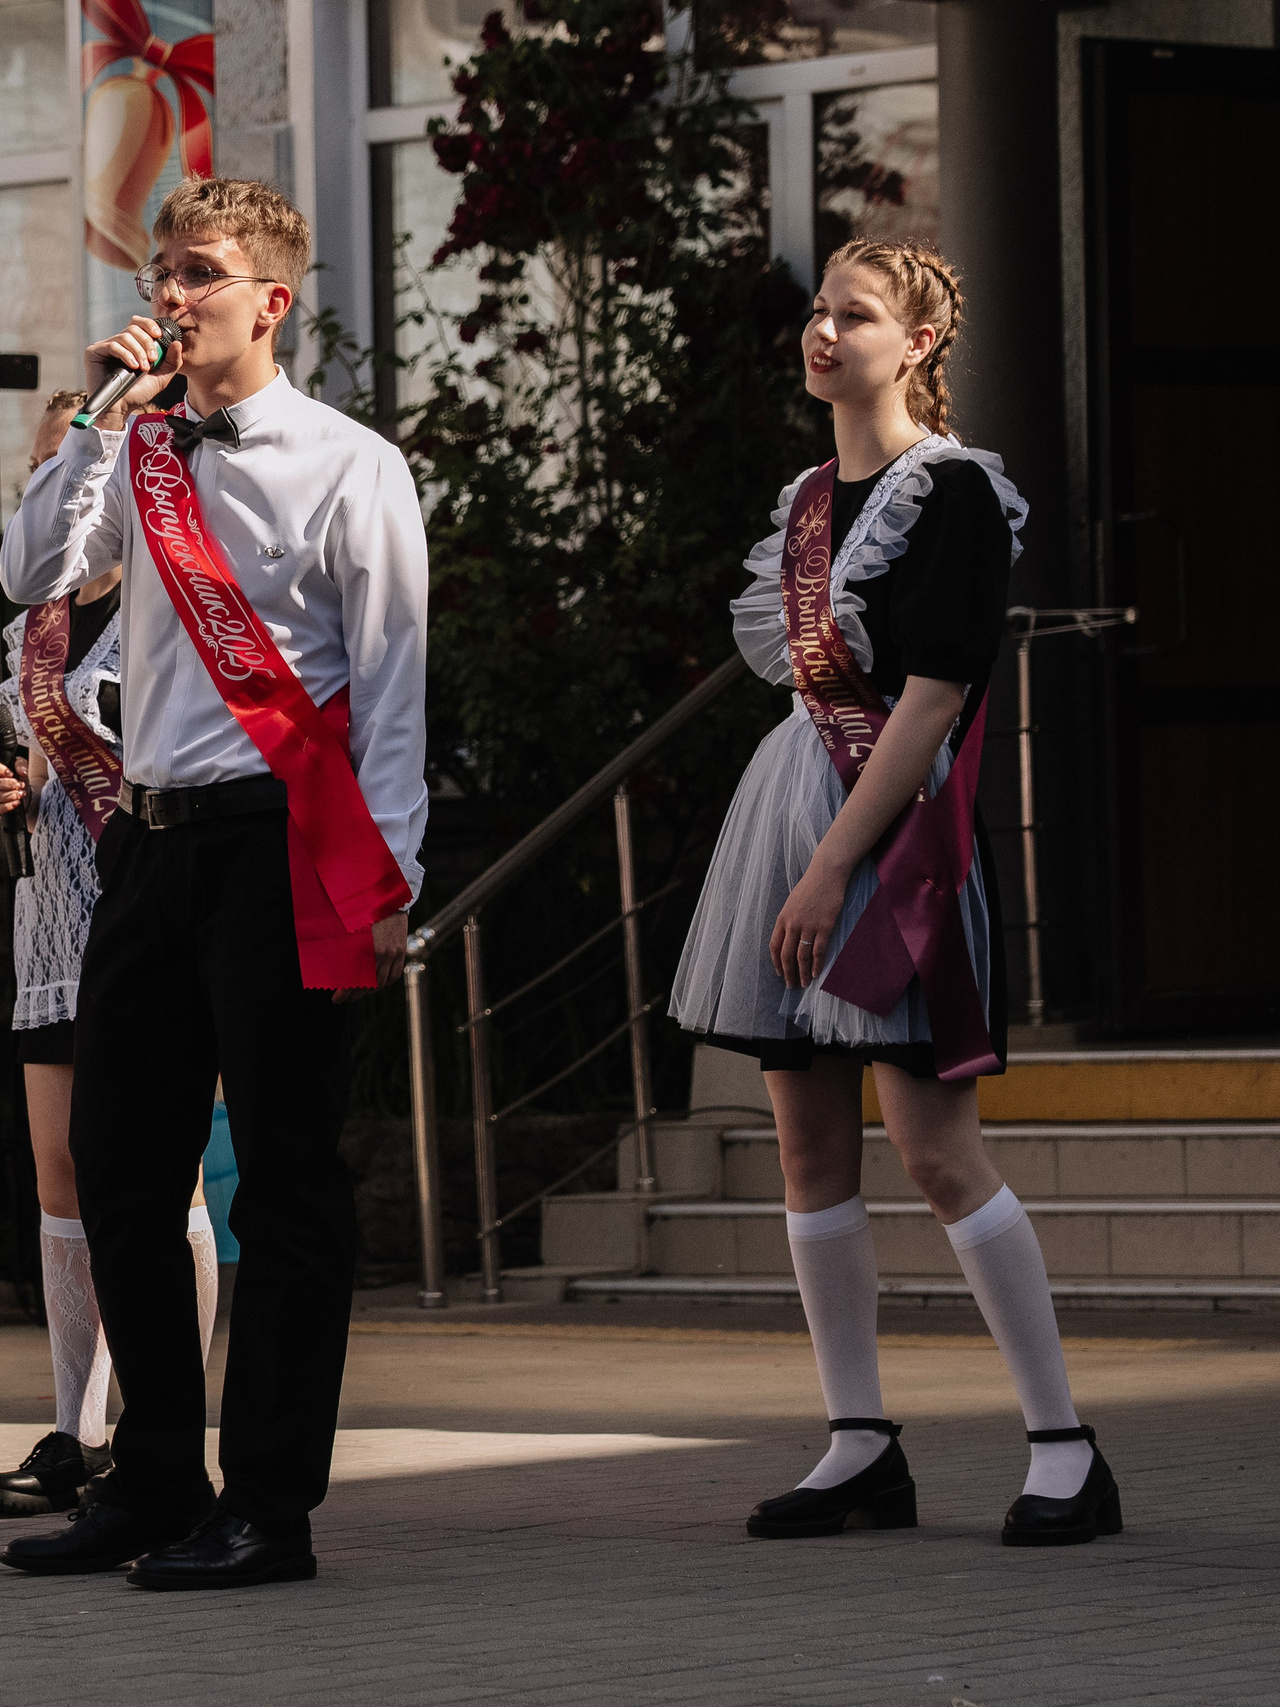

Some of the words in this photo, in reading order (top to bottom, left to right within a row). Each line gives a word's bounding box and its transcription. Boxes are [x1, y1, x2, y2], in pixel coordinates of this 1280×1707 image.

[135, 446, 231, 621] Выпускник
[206, 617, 277, 682] 2025
[789, 546, 873, 739] Выпускница
[28, 631, 112, 797] Выпускница
[803, 690, 829, 726] СОШ
